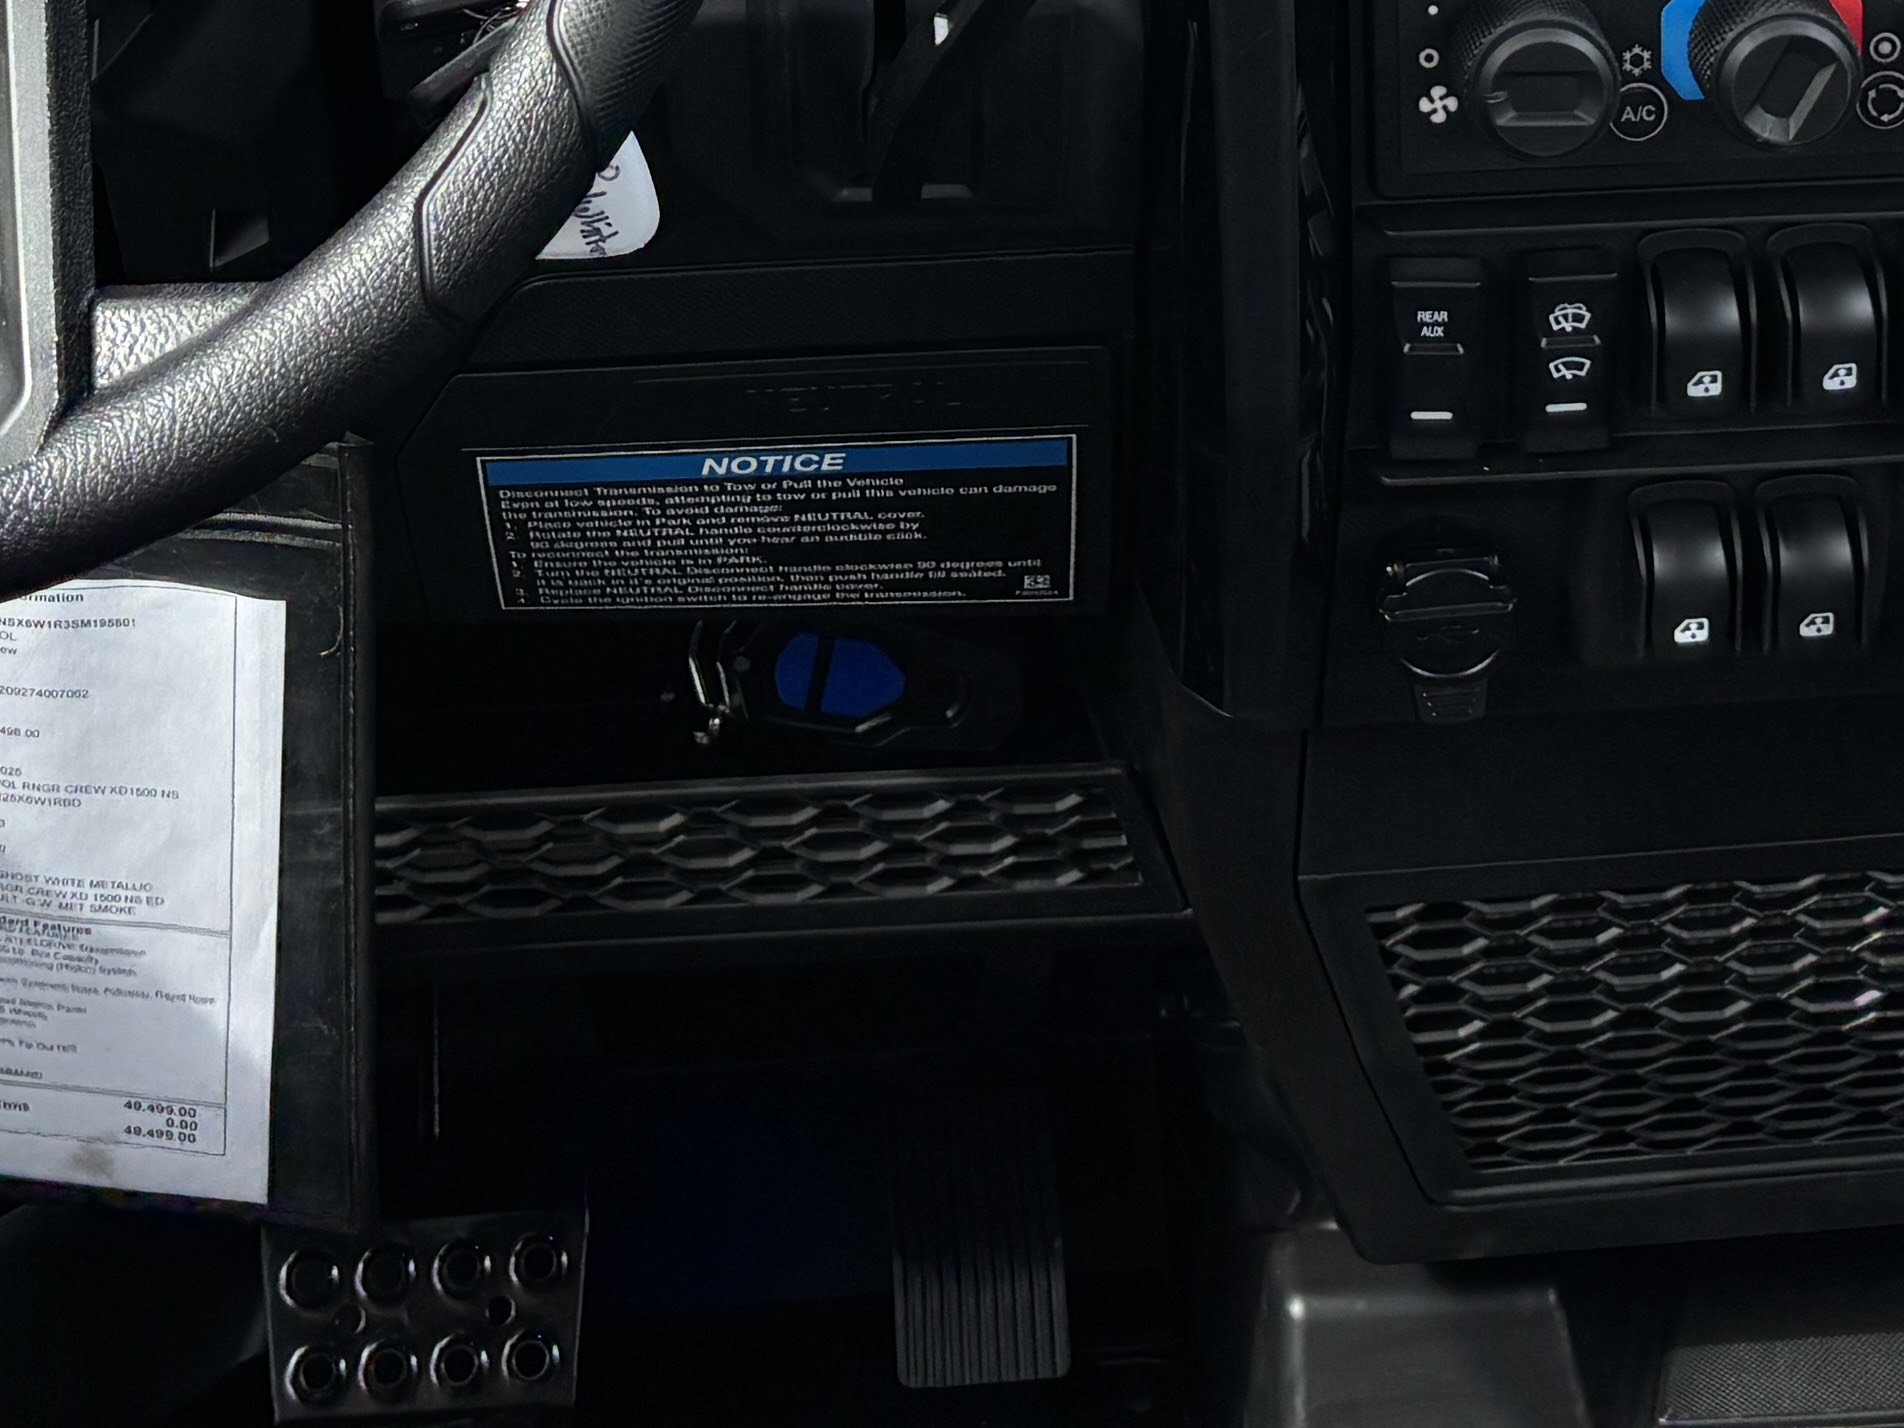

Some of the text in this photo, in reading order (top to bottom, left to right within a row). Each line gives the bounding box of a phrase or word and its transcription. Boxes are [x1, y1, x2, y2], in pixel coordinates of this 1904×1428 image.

[1620, 104, 1656, 122] A/C
[1417, 310, 1449, 323] REAR
[1420, 325, 1444, 337] AUX
[701, 453, 846, 475] NOTICE
